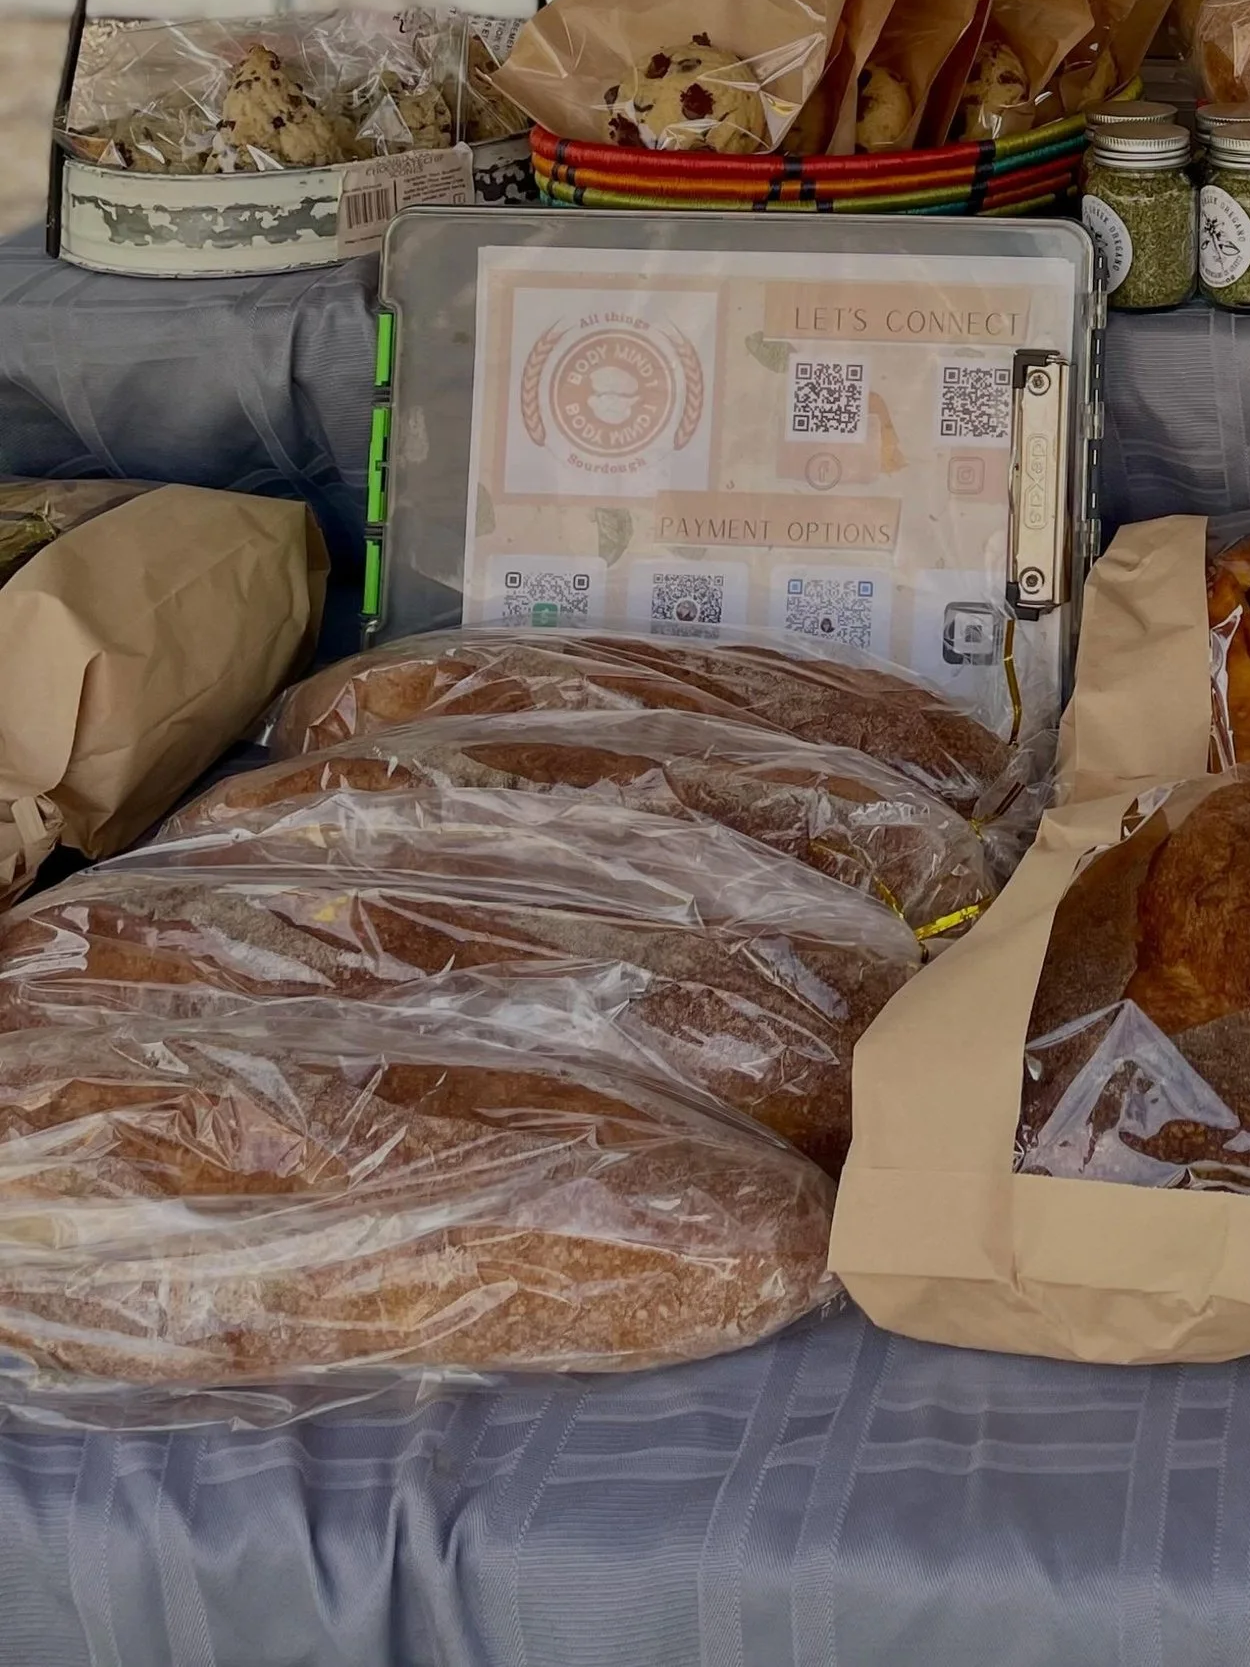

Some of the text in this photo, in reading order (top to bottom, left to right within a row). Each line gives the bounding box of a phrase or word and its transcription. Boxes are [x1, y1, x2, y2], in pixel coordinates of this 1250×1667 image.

[579, 312, 652, 331] All things
[794, 306, 1021, 337] LET'S CONNECT
[567, 343, 608, 386] BODY
[613, 343, 653, 378] MIND
[567, 452, 647, 474] Sourdough
[661, 516, 891, 545] PAYMENT OPTIONS
